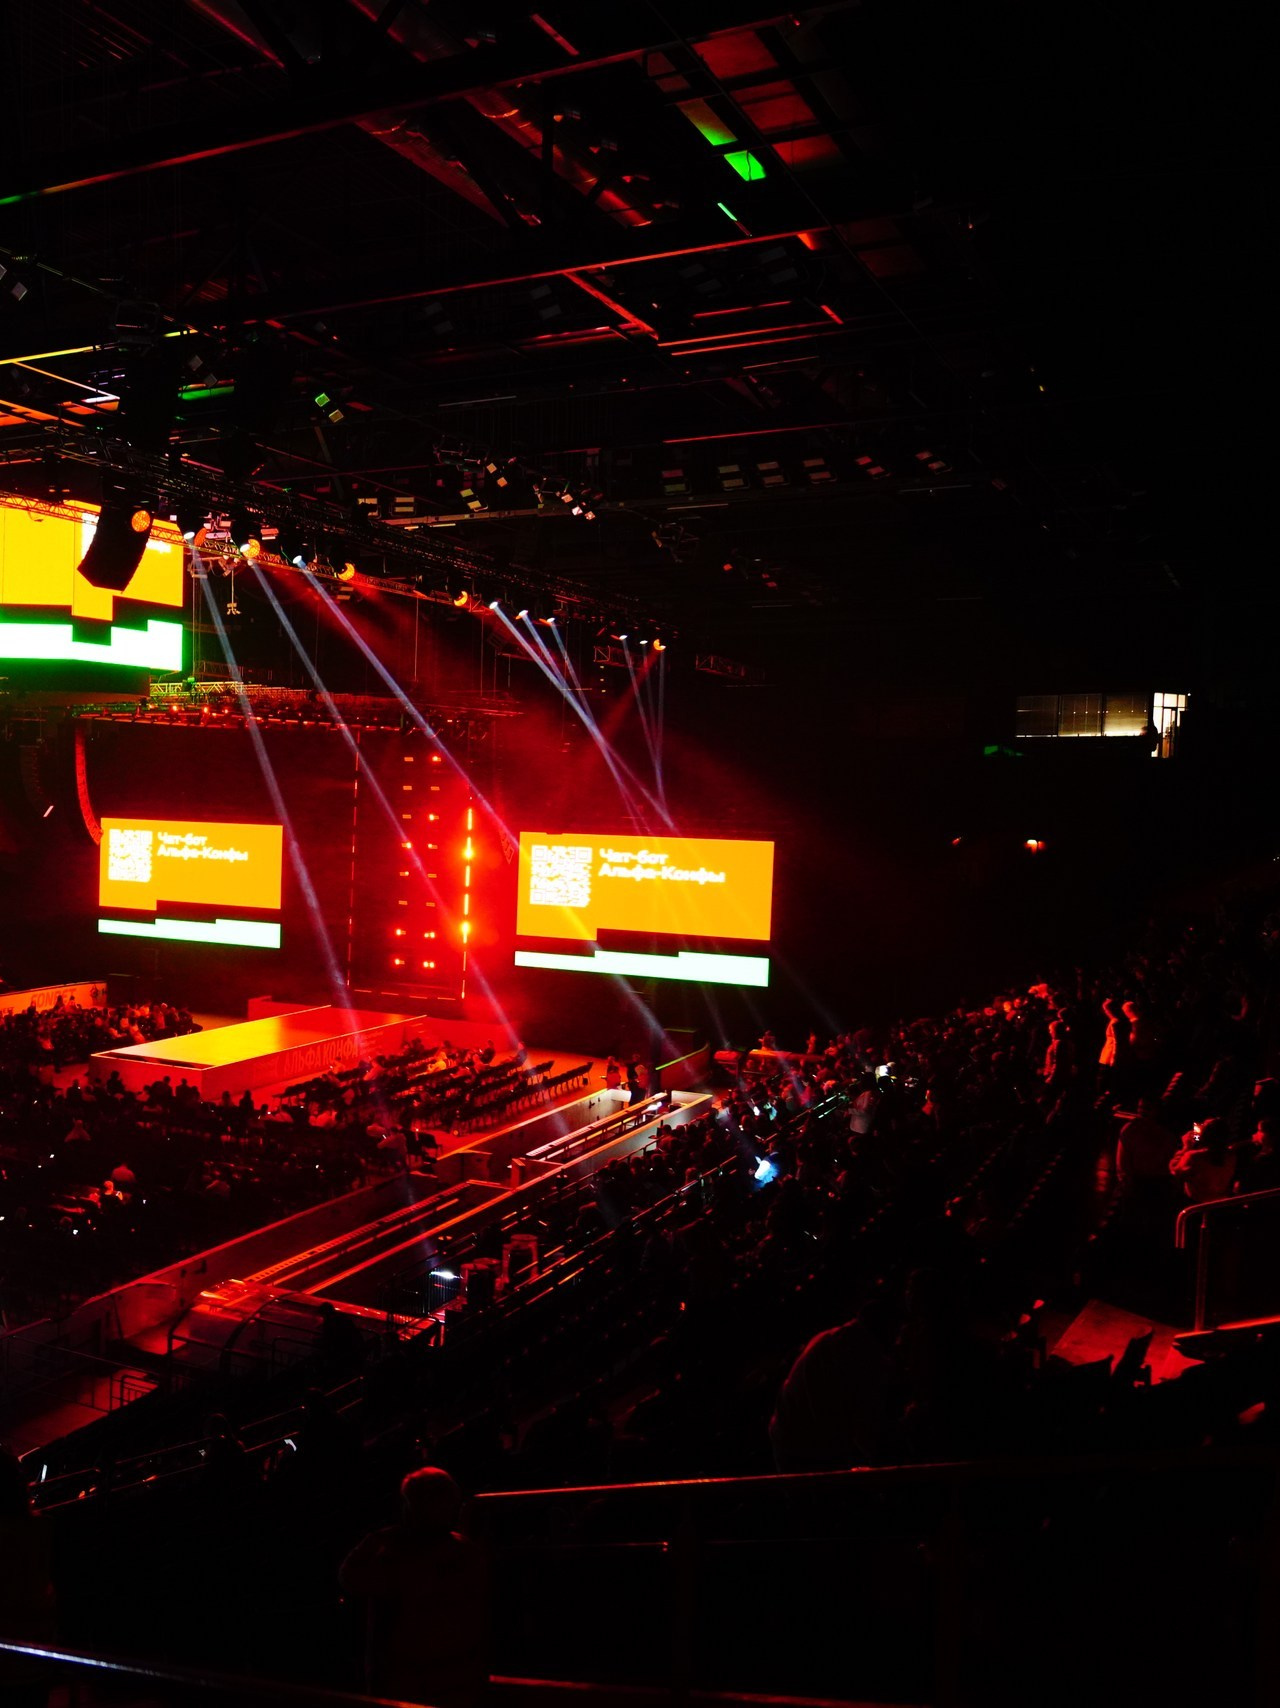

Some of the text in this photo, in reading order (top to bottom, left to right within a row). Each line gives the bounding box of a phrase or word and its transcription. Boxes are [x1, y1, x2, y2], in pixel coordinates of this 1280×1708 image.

[157, 832, 208, 846] Чат-бот
[599, 847, 669, 865] Чат-бот
[598, 862, 726, 886] Альфа-Конфы
